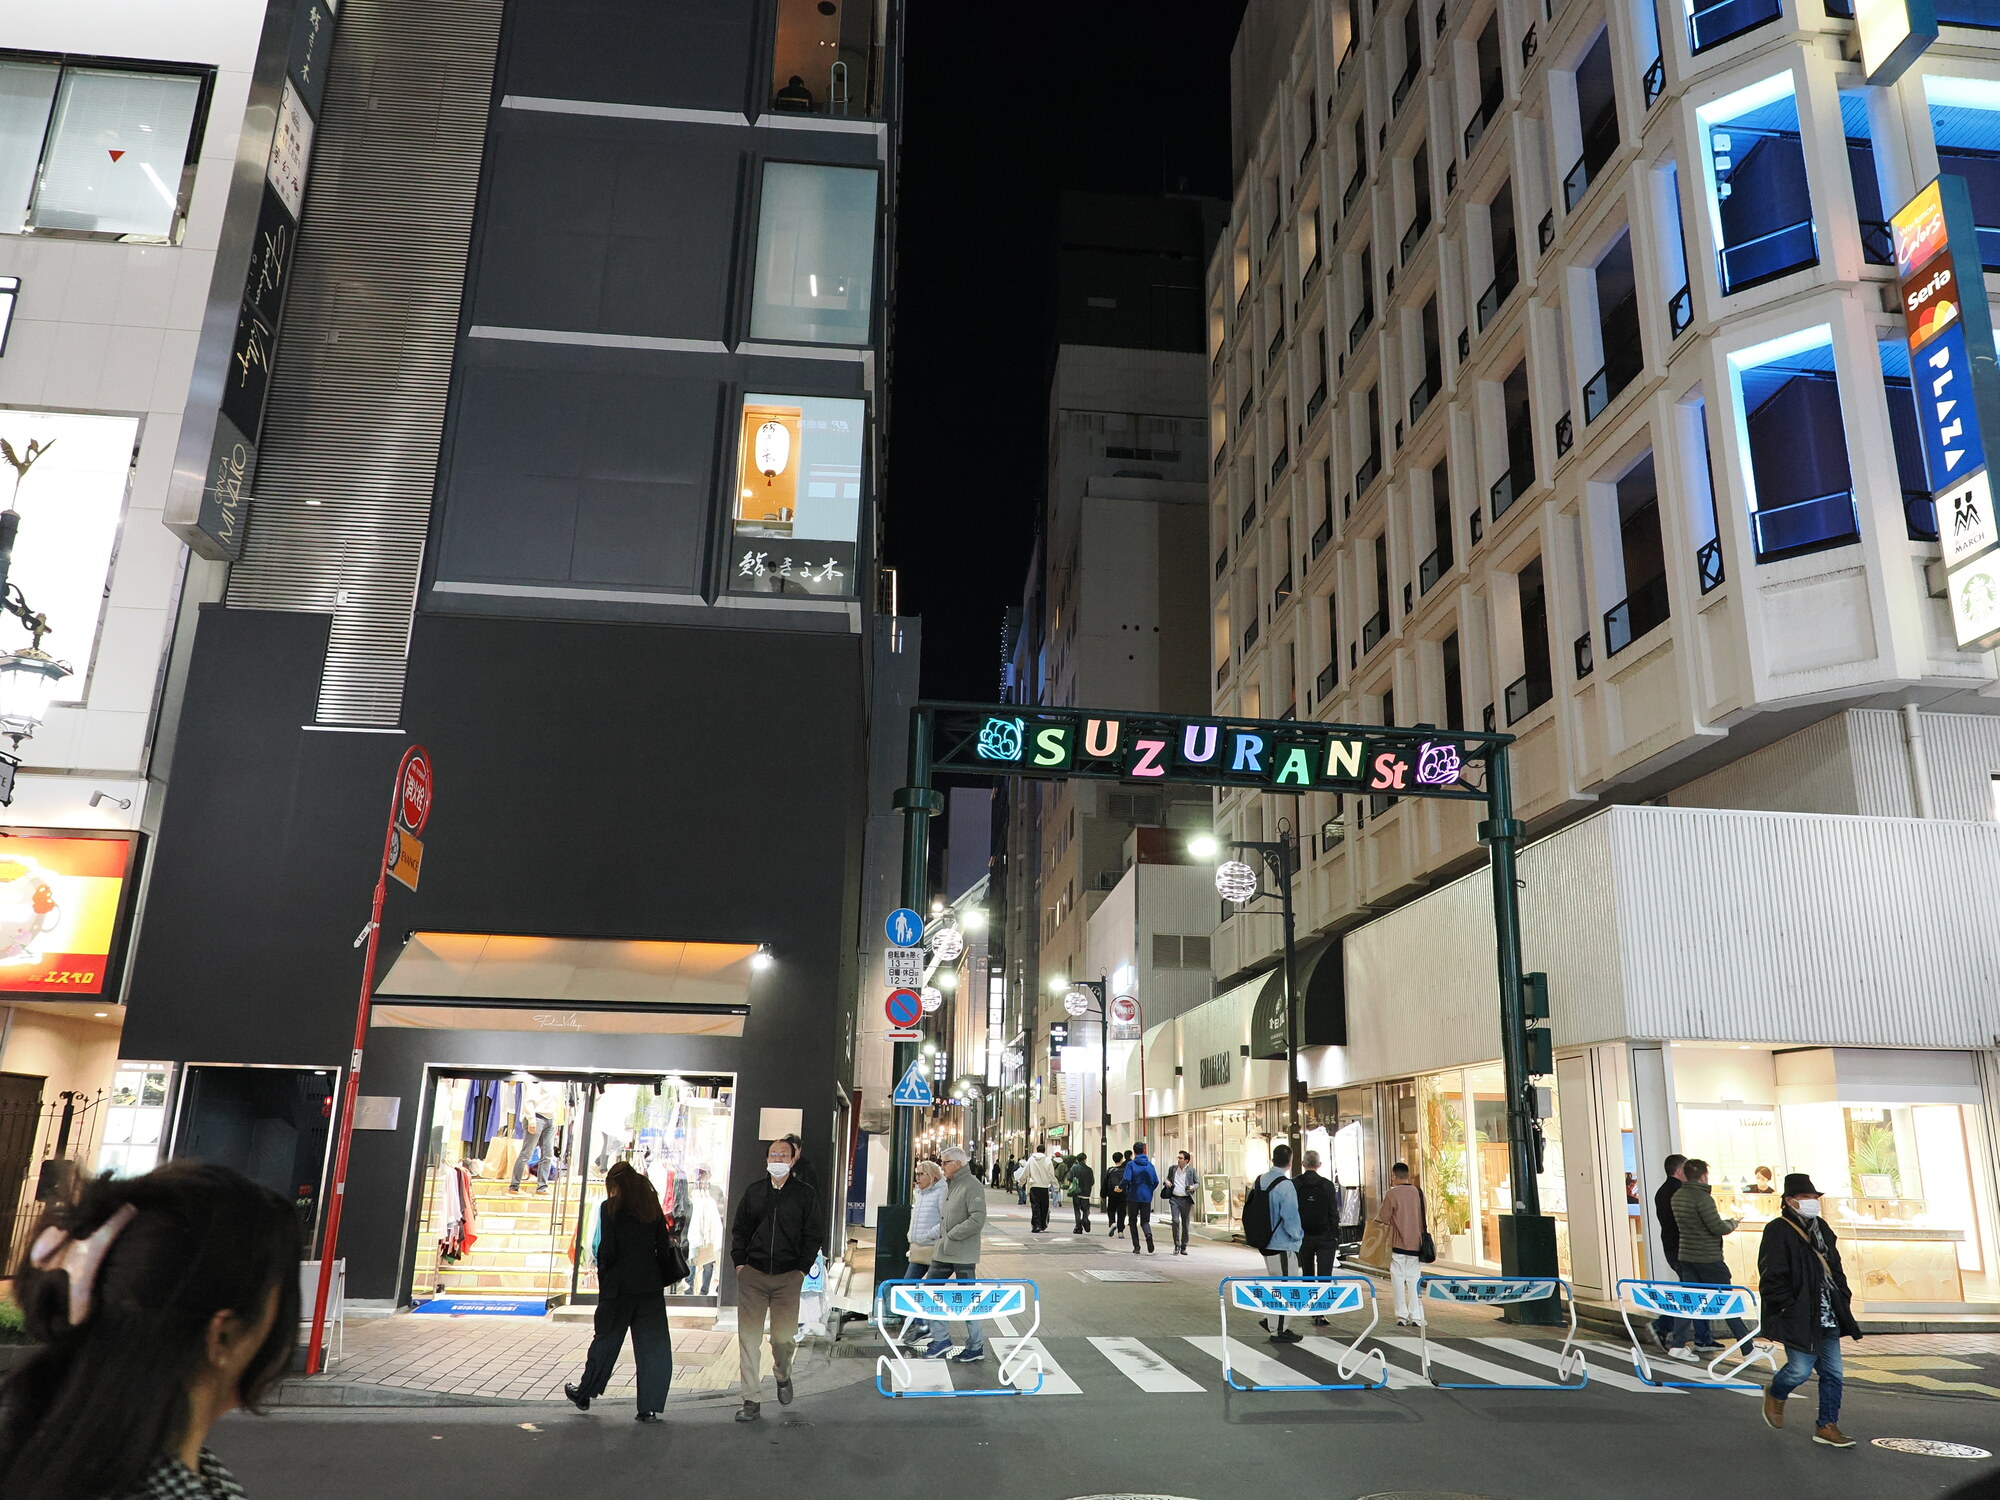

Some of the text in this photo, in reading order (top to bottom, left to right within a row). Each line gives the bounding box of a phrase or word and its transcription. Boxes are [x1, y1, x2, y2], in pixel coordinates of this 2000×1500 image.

[1899, 203, 1937, 237] Workman
[1898, 213, 1941, 264] Colors
[1907, 268, 1951, 311] Seria
[1928, 346, 1966, 472] PLAZA
[214, 456, 230, 504] GINZA
[218, 443, 246, 545] MIYAKO
[1954, 531, 1986, 555] MARCH
[1033, 719, 1409, 790] SUZURAN St
[404, 773, 425, 812] 消火栓
[44, 971, 95, 984] エスペロ
[913, 1292, 1001, 1304] 車両通行止
[1253, 1288, 1338, 1300] 車両通行止
[1448, 1285, 1532, 1295] 車両通行止
[1648, 1290, 1726, 1306] 車両通行止
